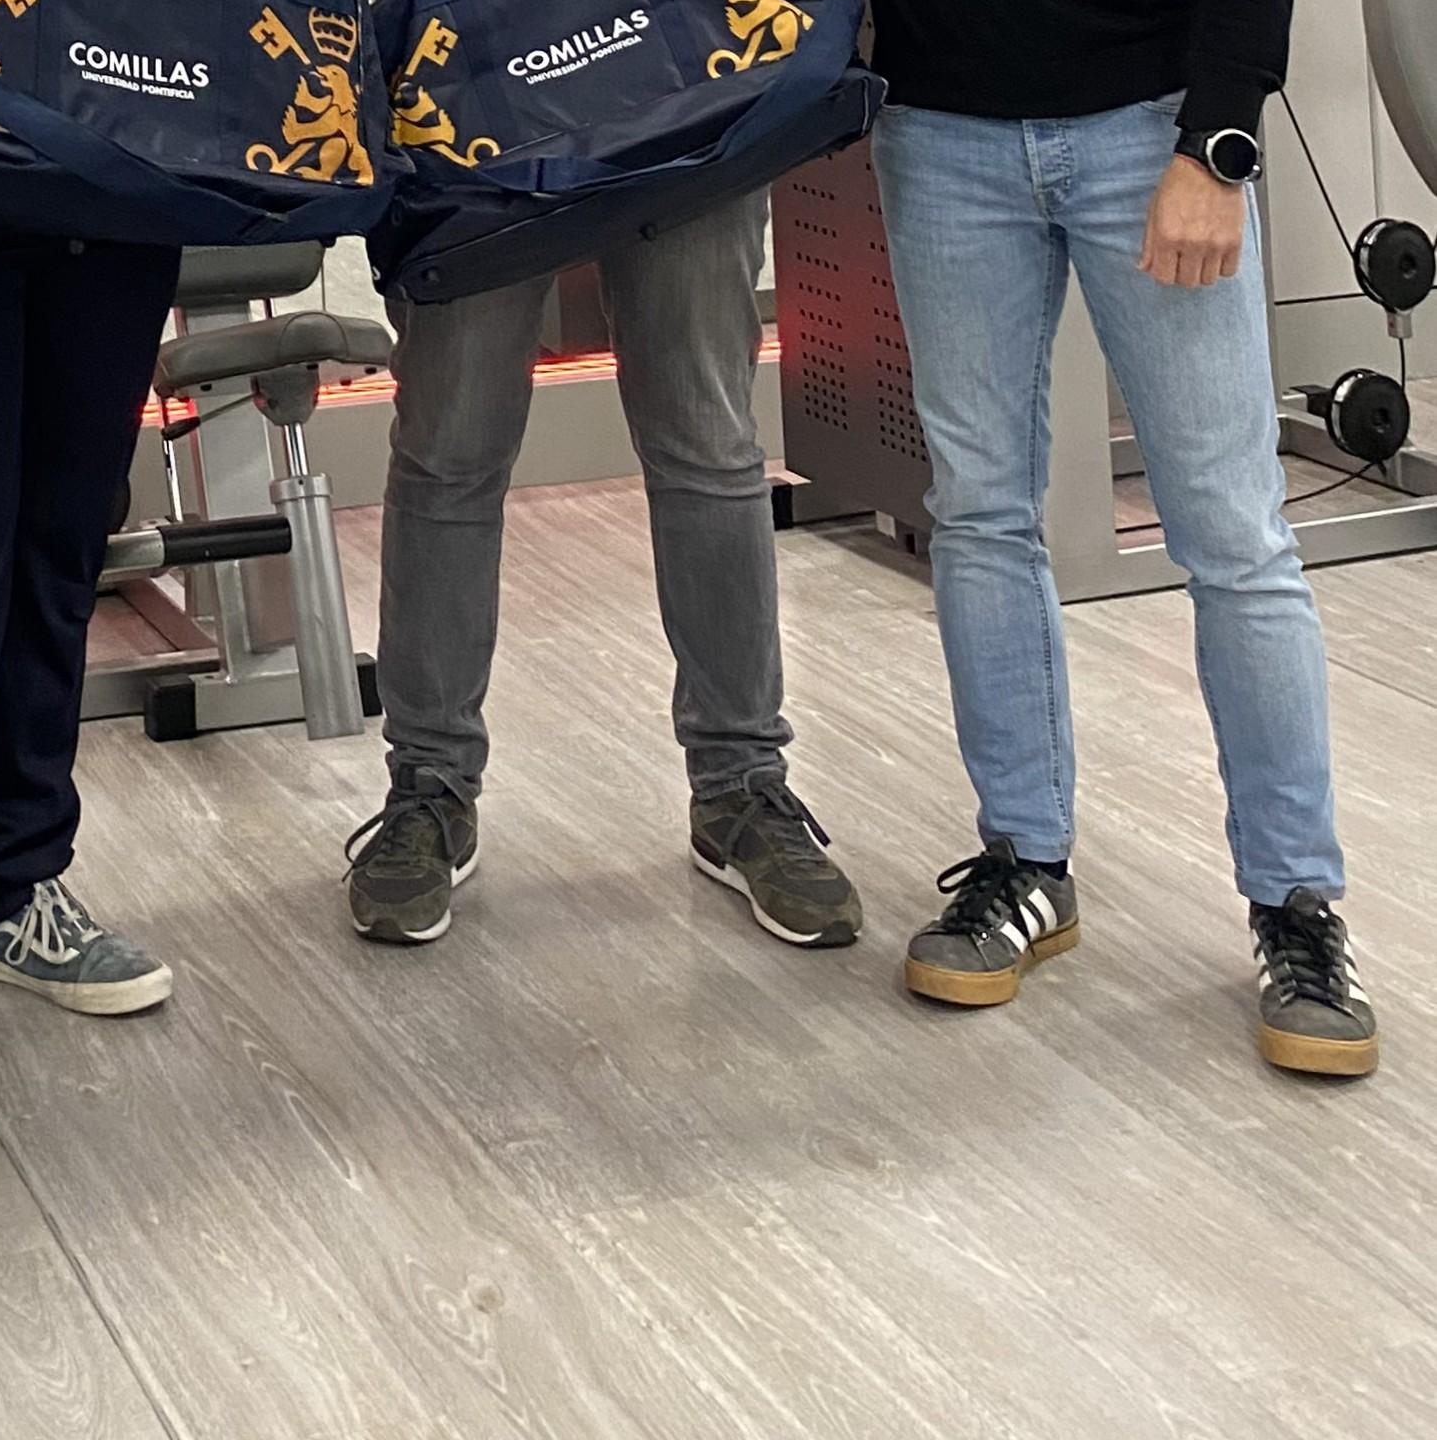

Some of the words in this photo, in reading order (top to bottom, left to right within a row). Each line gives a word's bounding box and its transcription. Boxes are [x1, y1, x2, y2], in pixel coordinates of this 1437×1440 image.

[69, 42, 210, 88] COMILLAS
[507, 10, 650, 76] COMILLAS
[526, 57, 589, 85] UNIVERSIDAD
[591, 34, 643, 61] PONTIFICIA
[81, 70, 140, 92] UNIVERSIDAD
[142, 83, 195, 100] PONTIFICIA
